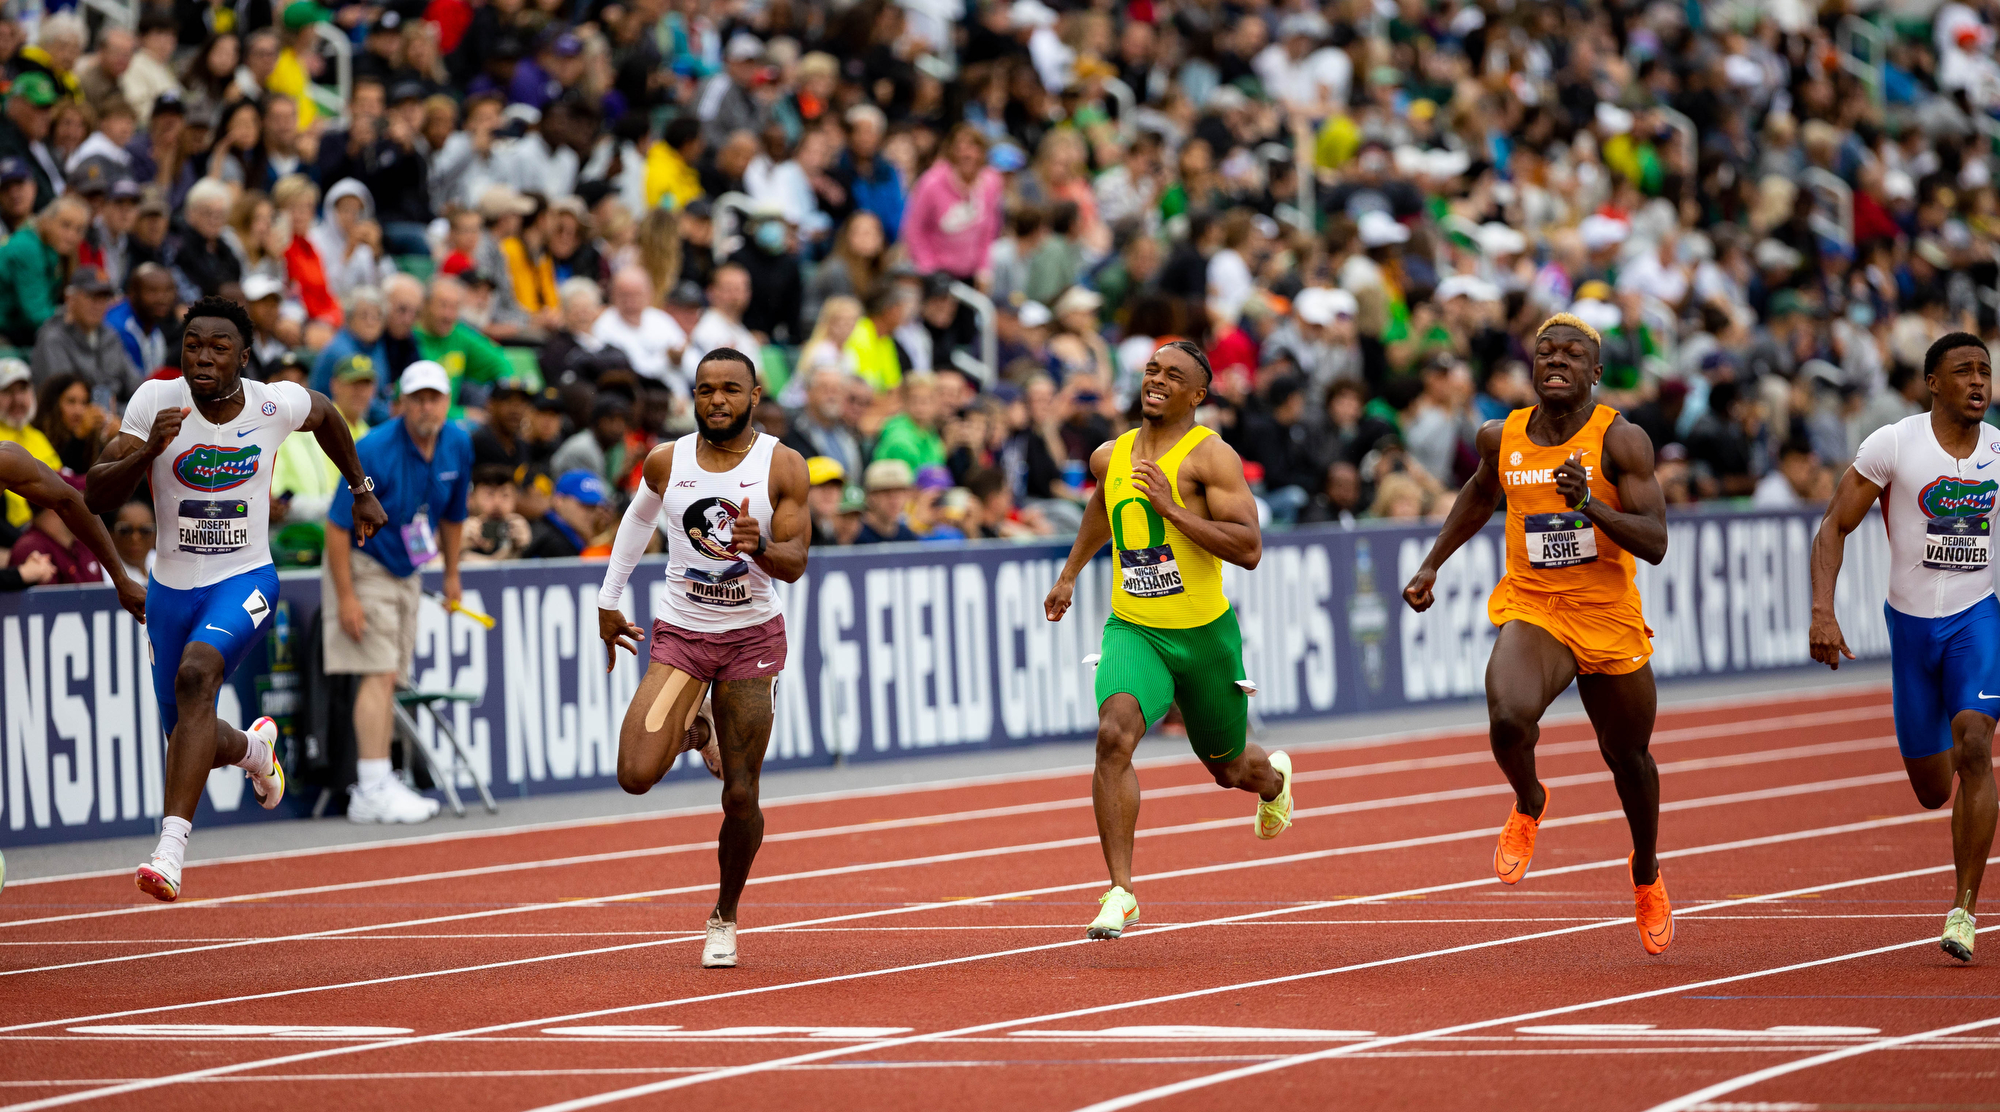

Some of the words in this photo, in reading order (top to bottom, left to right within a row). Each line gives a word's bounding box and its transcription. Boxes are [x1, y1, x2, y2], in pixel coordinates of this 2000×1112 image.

[674, 480, 698, 488] ACC
[1504, 466, 1594, 485] TENNEE
[195, 520, 231, 530] JOSEPH
[179, 528, 248, 546] FAHNBULLEH
[1542, 531, 1576, 543] FAVOUR
[1941, 536, 1977, 547] DEDRICK
[1542, 541, 1582, 559] ASHE
[1926, 544, 1987, 563] VANOVER
[1134, 565, 1160, 577] MICAH
[1123, 570, 1182, 591] WILLIAMS
[692, 581, 746, 600] MARTIN
[1727, 515, 1812, 671] FIELD
[249, 595, 268, 615] 7
[818, 570, 862, 755] &
[864, 561, 995, 752] FIELD
